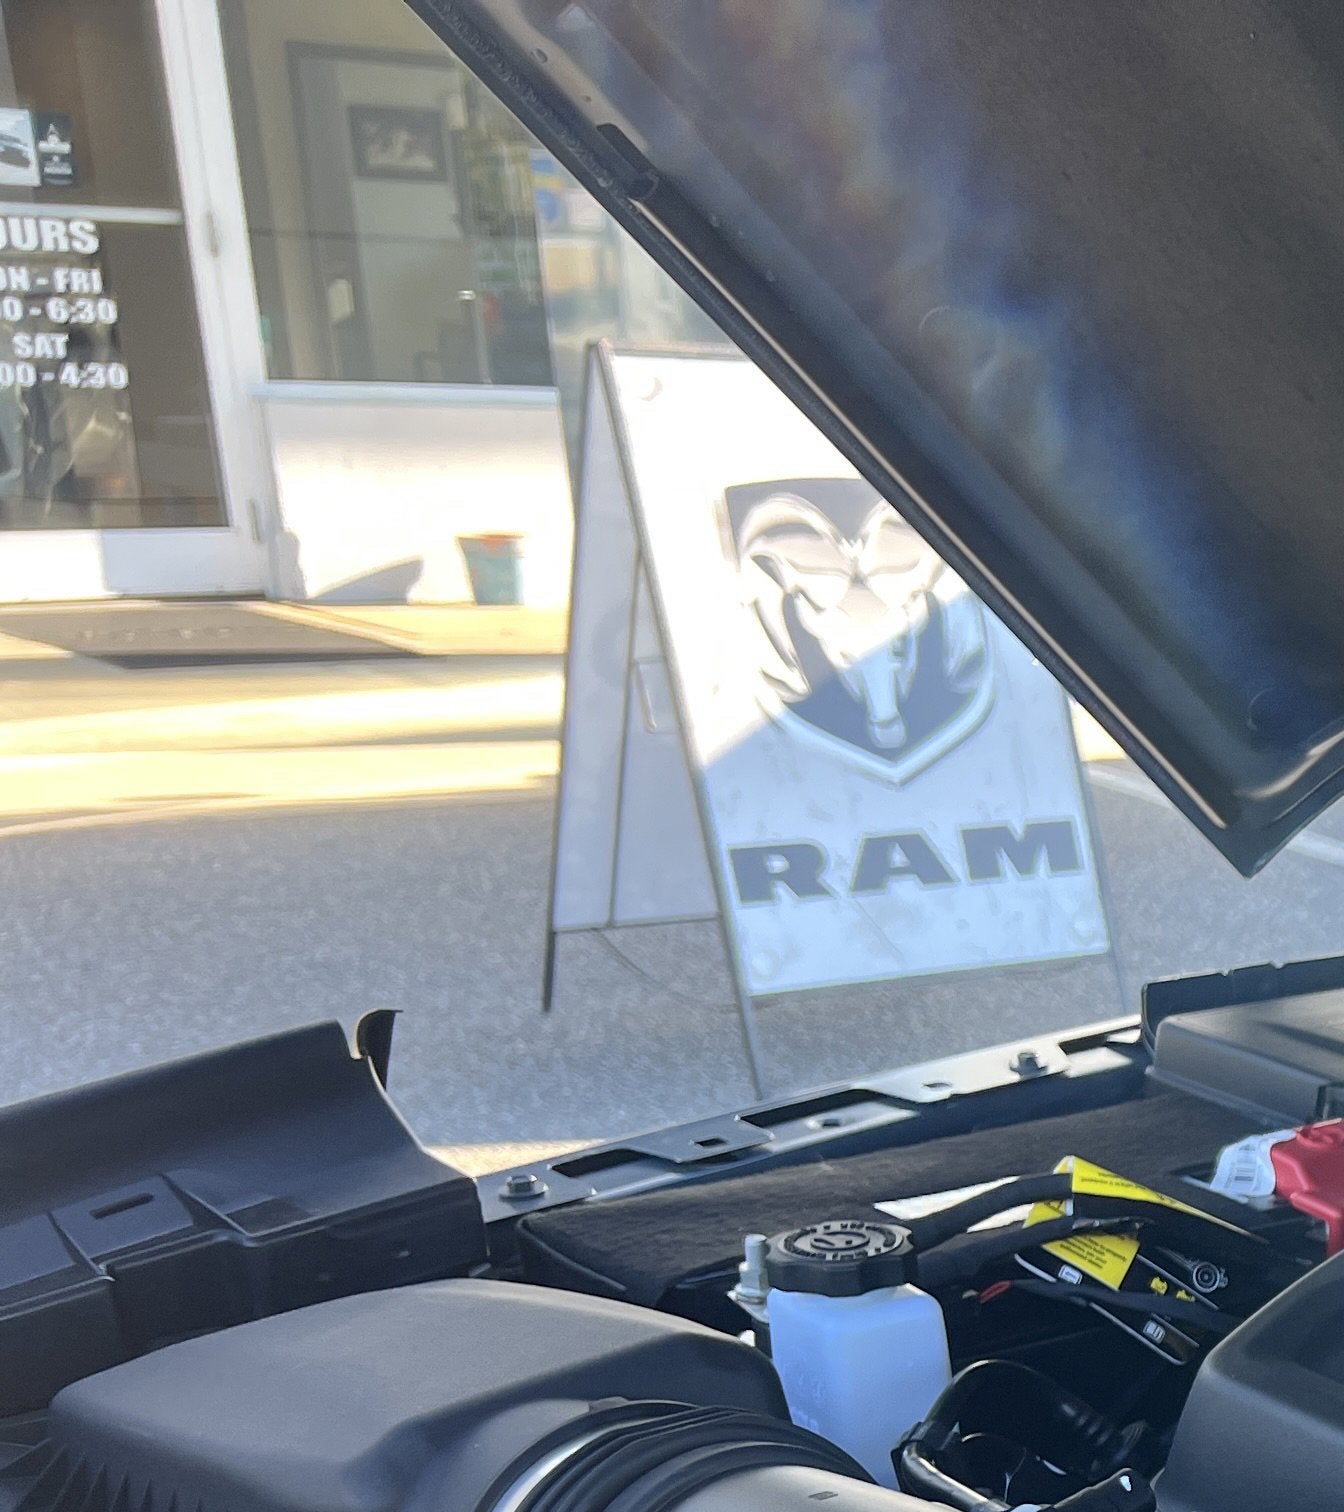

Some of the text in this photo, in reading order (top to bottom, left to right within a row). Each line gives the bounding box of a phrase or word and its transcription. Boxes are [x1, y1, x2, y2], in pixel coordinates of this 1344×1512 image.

[0, 217, 100, 254] URS
[52, 268, 104, 294] FRI
[46, 297, 118, 324] 6:30
[12, 333, 70, 359] SAT
[59, 361, 128, 390] 4:30
[726, 817, 1086, 908] RAM
